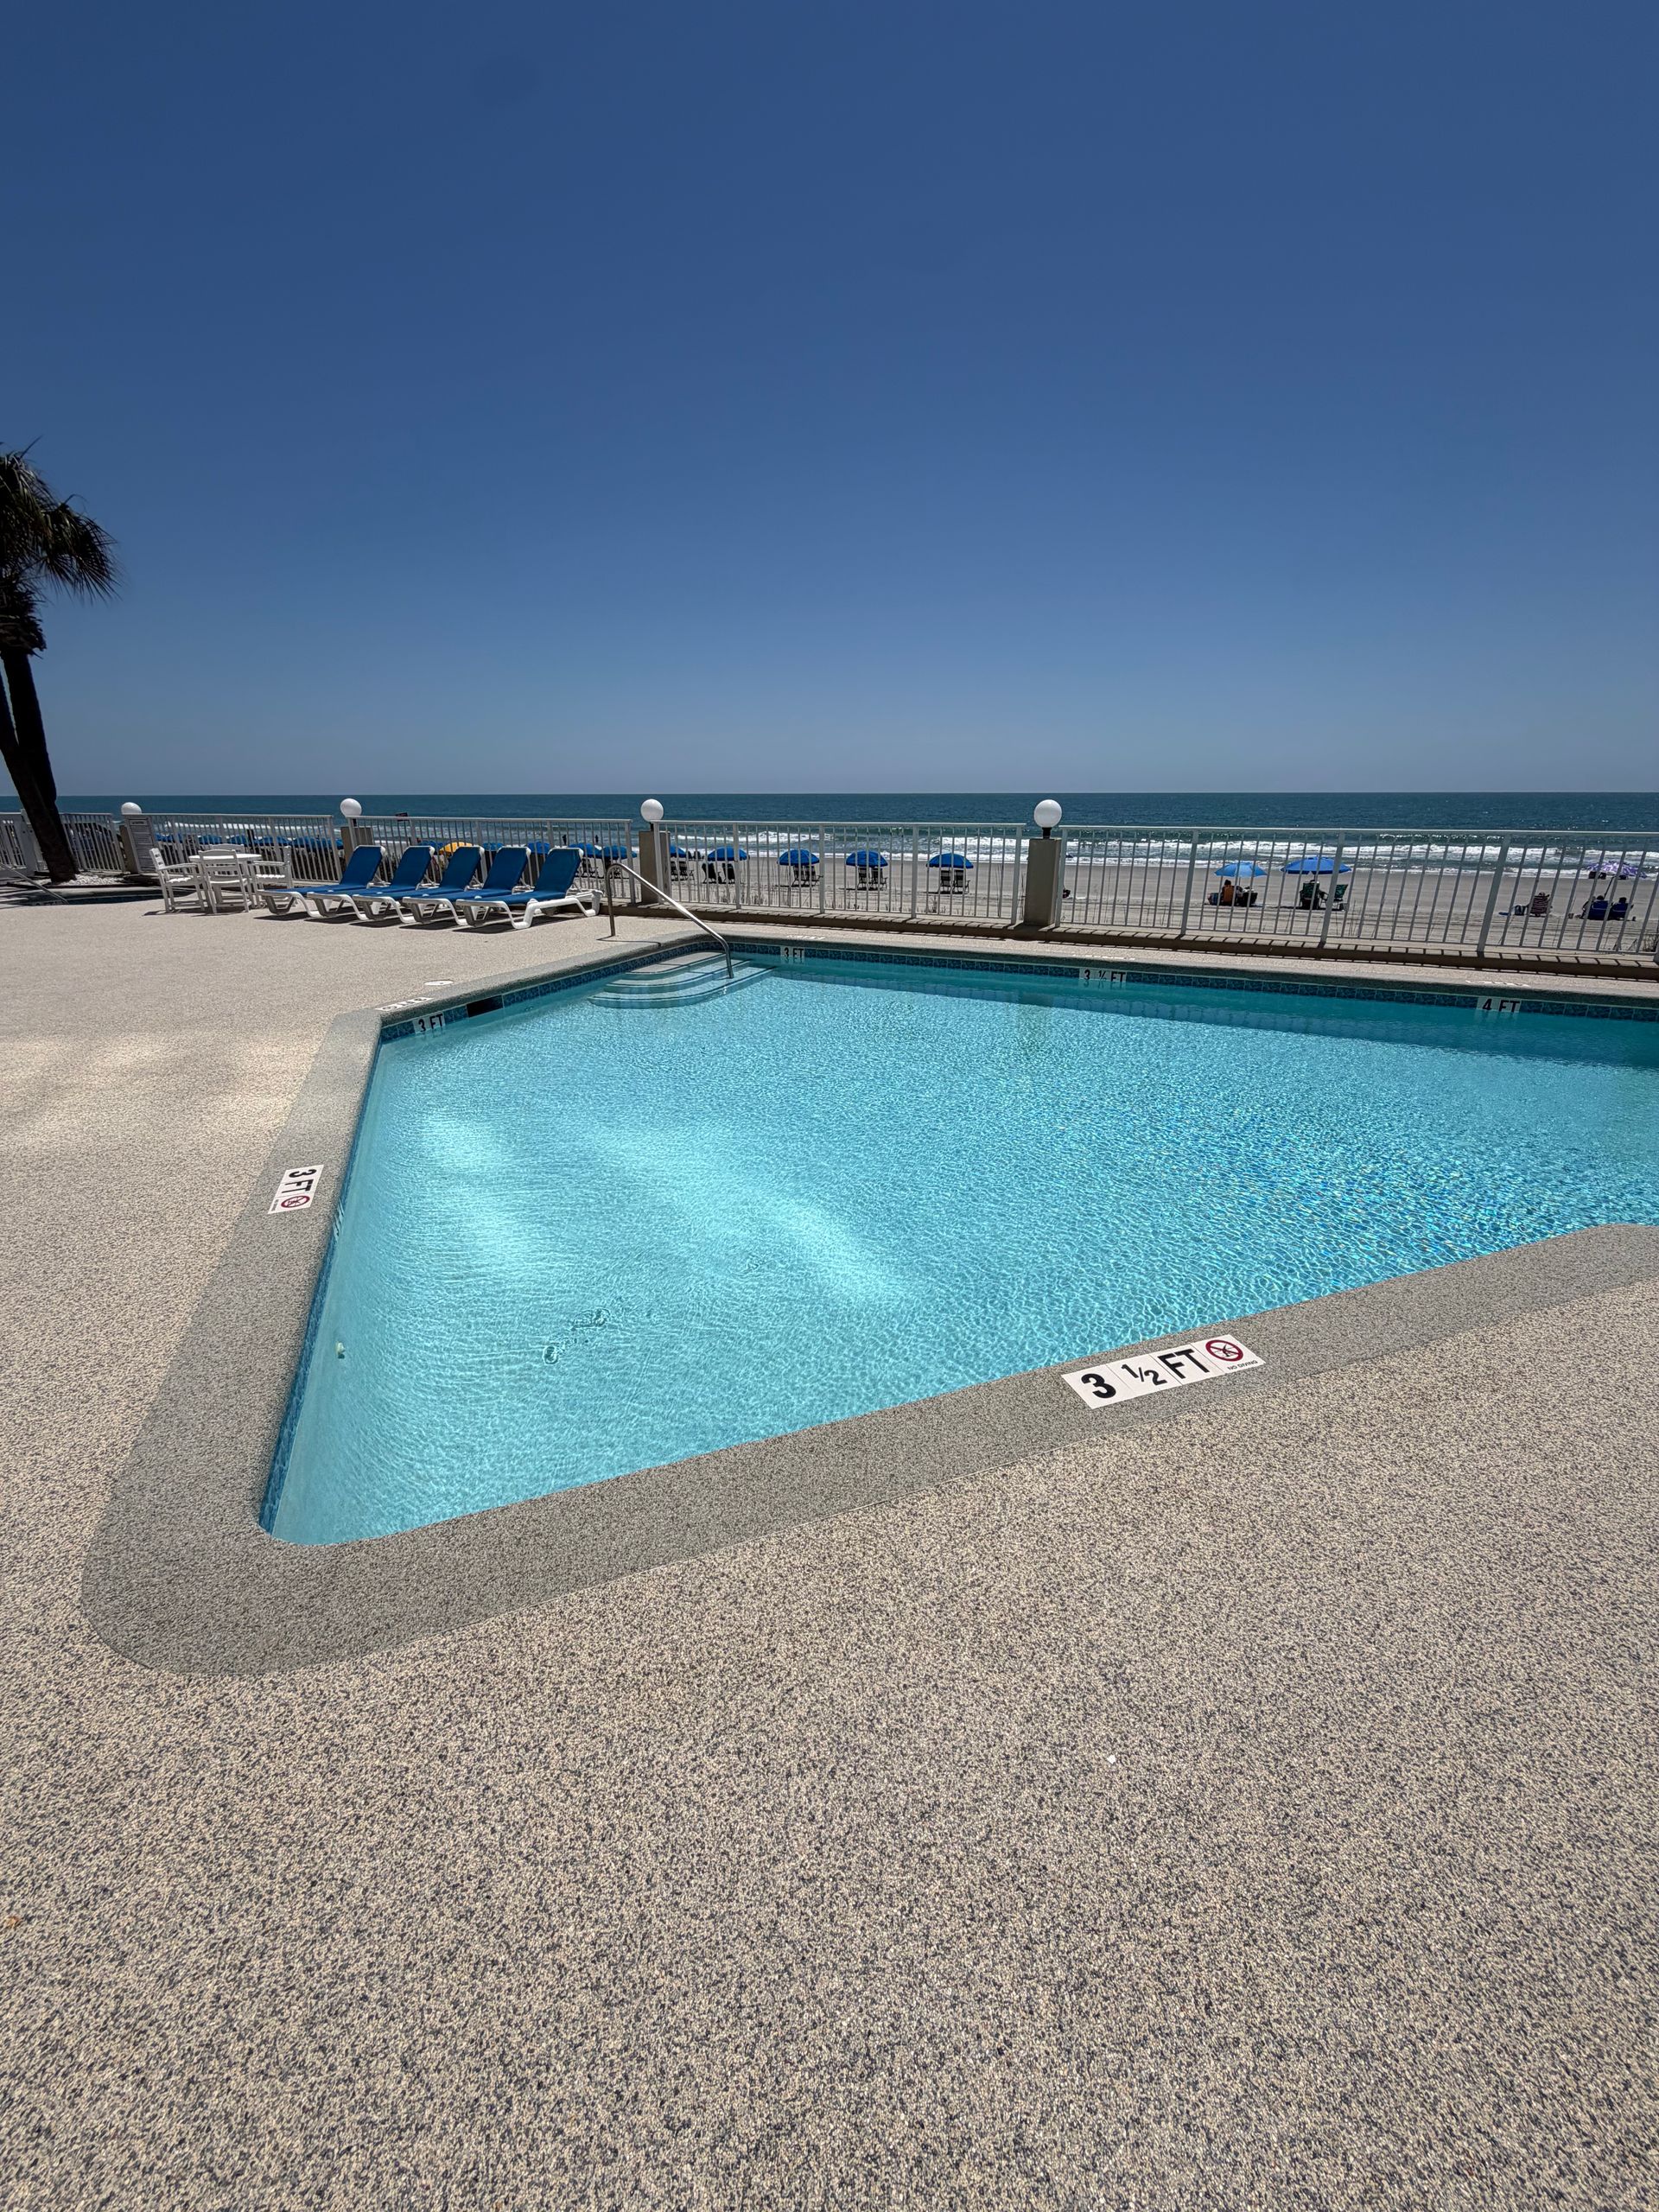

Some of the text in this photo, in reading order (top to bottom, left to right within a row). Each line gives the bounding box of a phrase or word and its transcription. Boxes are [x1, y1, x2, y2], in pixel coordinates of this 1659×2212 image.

[784, 947, 804, 958] 3 FT
[1084, 969, 1090, 980] 3
[1110, 970, 1126, 982] FT
[1482, 998, 1520, 1013] 4 FT
[418, 1013, 443, 1032] 3 FT
[281, 1169, 317, 1194] 3 FT
[1237, 1359, 1258, 1369] DIVING
[1081, 1373, 1116, 1399] 3
[1157, 1348, 1210, 1380] FT
